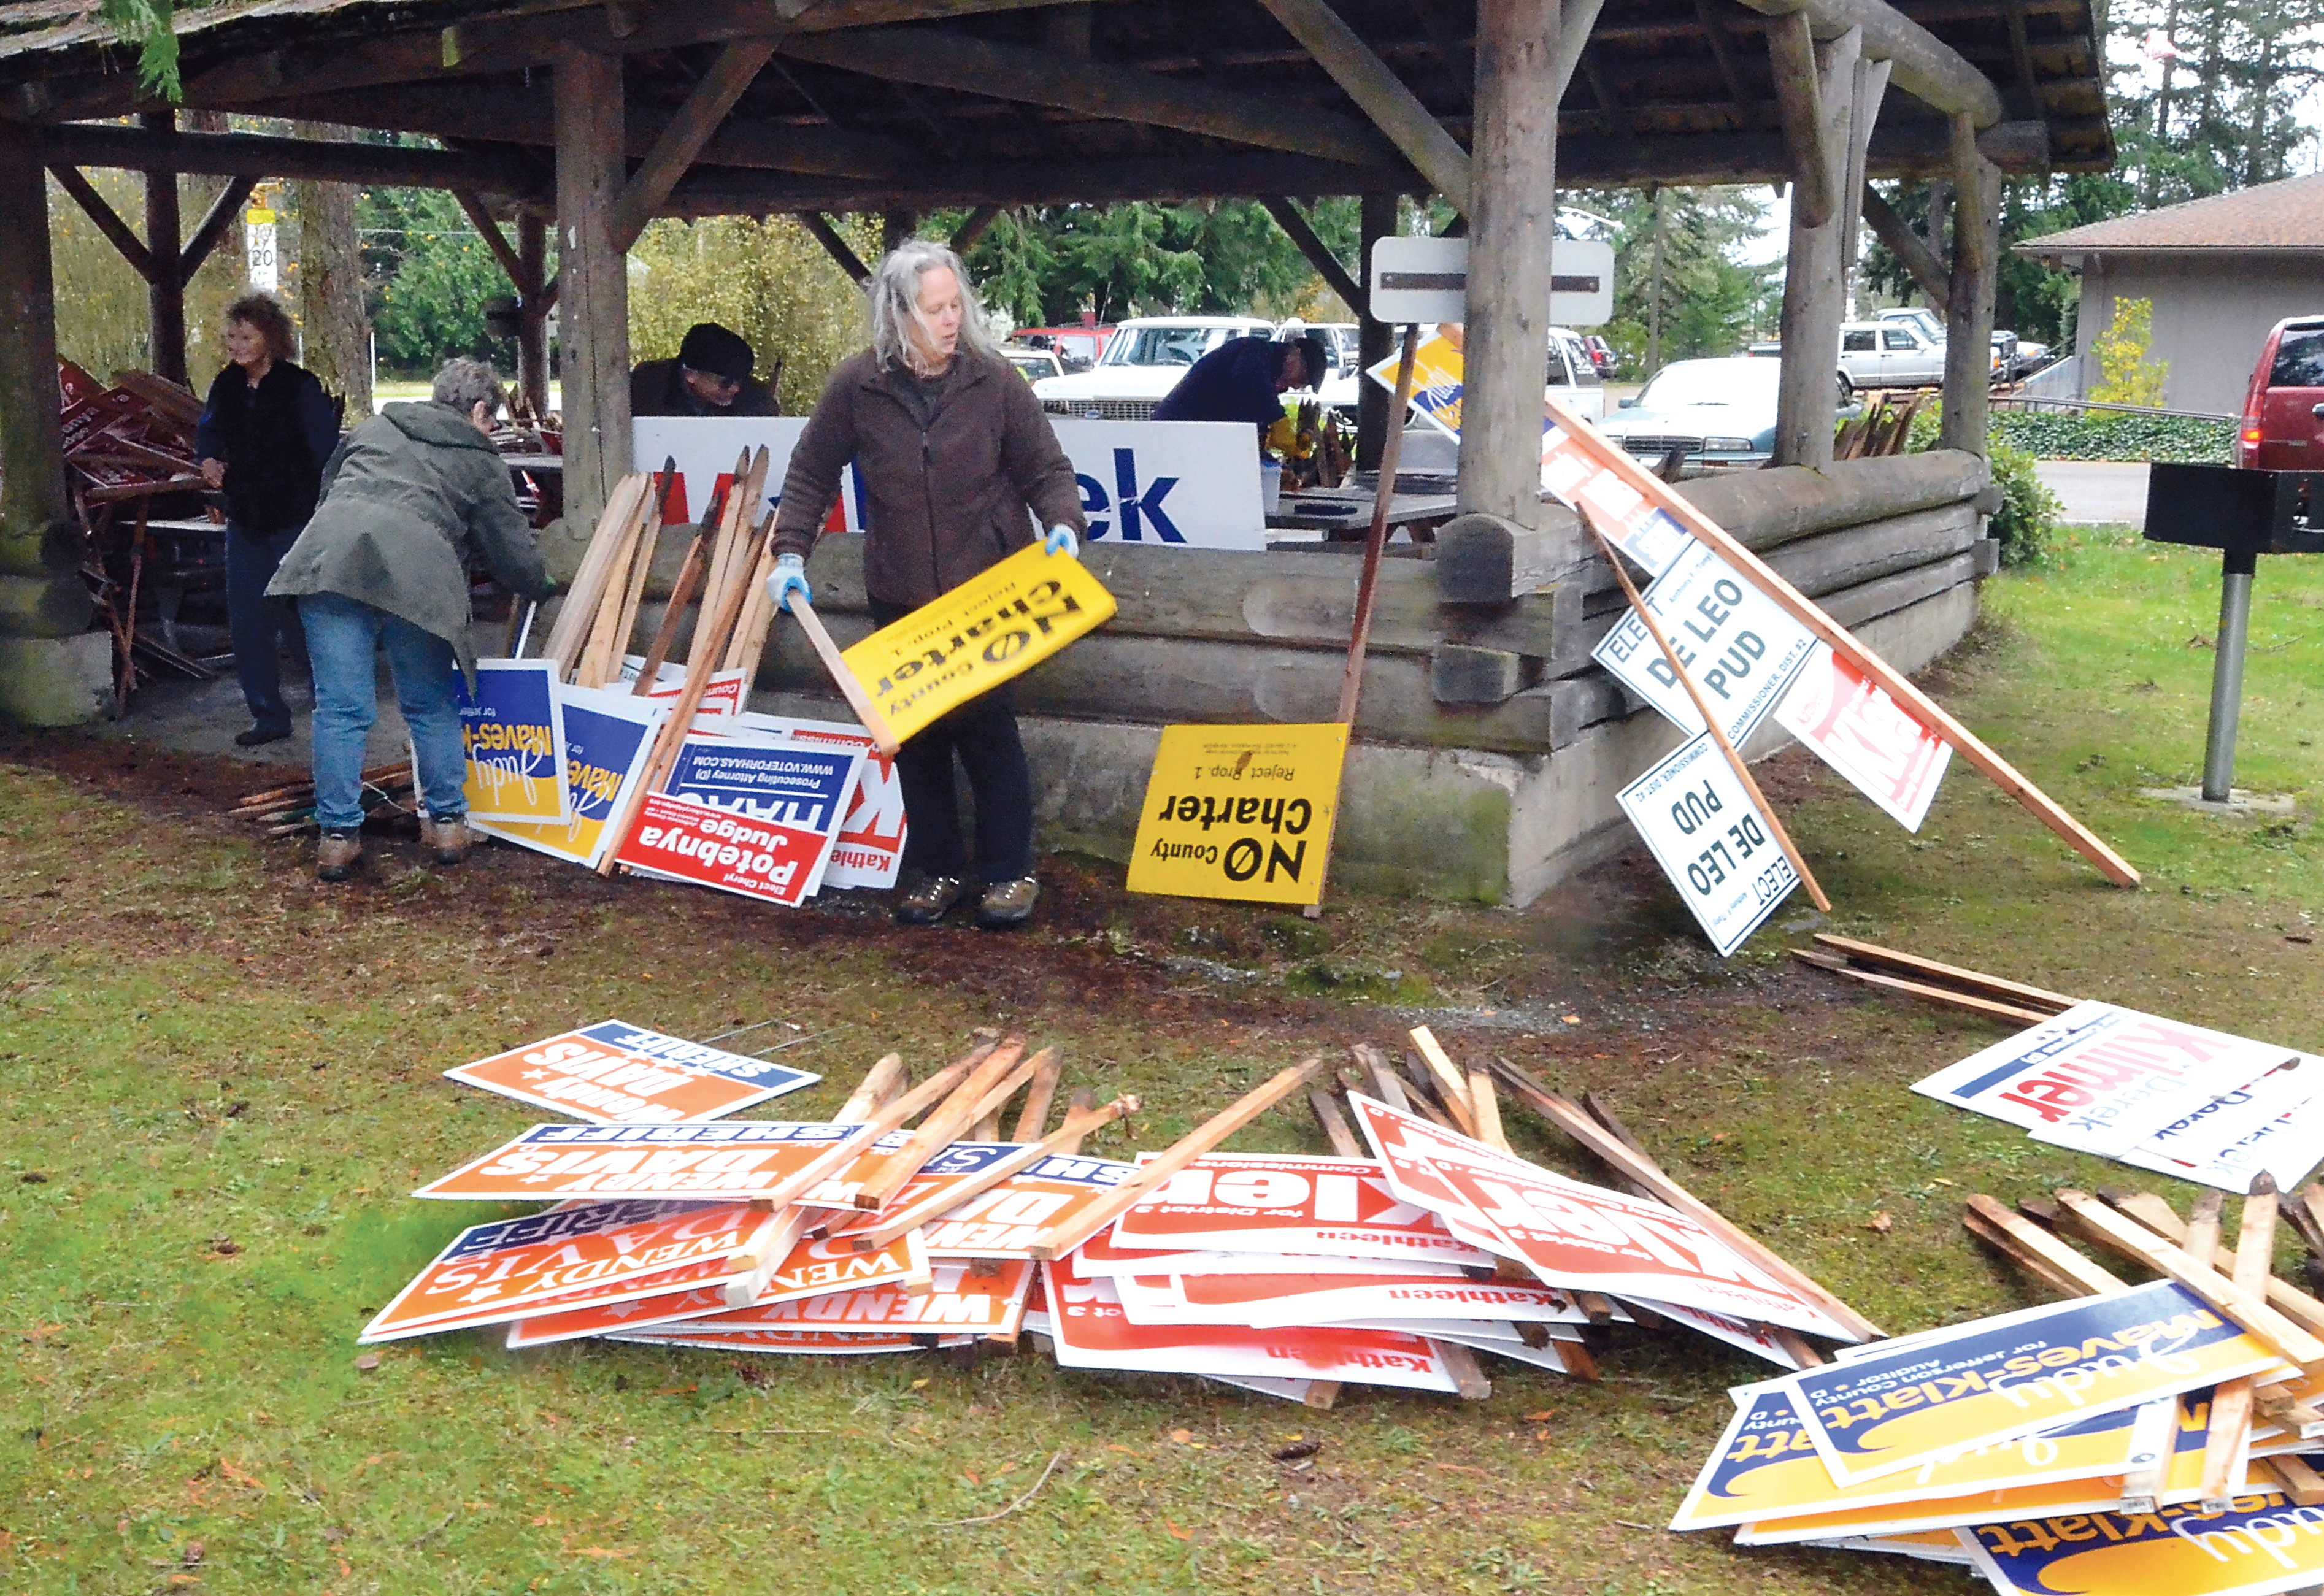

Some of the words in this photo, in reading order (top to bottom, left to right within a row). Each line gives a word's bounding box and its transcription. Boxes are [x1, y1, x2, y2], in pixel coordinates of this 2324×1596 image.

[253, 250, 272, 266] 20
[1683, 578, 1744, 643] LEO
[875, 580, 1062, 698] Charter
[982, 595, 1081, 664] NO
[1609, 596, 1666, 664] ELET
[1704, 629, 1766, 700] PUD
[889, 662, 973, 717] County
[472, 740, 543, 806] Judy
[693, 755, 834, 775] WWW.VOTEFORHAAS.COM
[696, 769, 712, 781] (D)
[712, 770, 755, 783] Attorney
[758, 773, 820, 789] Prosecuting
[1194, 767, 1202, 780] 1
[1208, 765, 1242, 781] Prop.
[1250, 764, 1295, 781] Reject
[1158, 796, 1312, 835] Charter
[1671, 778, 1723, 835] PUD
[700, 818, 788, 852] Judge
[1150, 838, 1218, 865] County
[1728, 813, 1766, 859] DE
[638, 826, 798, 886] Potebnya
[1223, 837, 1307, 884] NO
[1687, 839, 1737, 896] LEO
[723, 873, 758, 889] Cheryl
[758, 880, 787, 896] Elect
[1752, 856, 1793, 907] ELECT
[521, 1042, 694, 1098] DAVIS
[612, 1029, 771, 1078] SHERIFF
[1997, 1021, 2233, 1124] Kilmer
[529, 1076, 686, 1121] Wendy
[2066, 1075, 2186, 1132] Derek
[536, 1124, 852, 1144] SHERIFF
[479, 1148, 780, 1176] DAVIS
[553, 1170, 778, 1192] WENDY
[1152, 1205, 1258, 1216] District
[1263, 1208, 1303, 1218] for
[425, 1208, 748, 1295] DAVIS
[1316, 1231, 1479, 1254] Kathleen
[520, 1230, 738, 1294] WENDY
[761, 1293, 990, 1322] WENDY
[1389, 1286, 1554, 1307] Kathleen
[1988, 1322, 2200, 1408] Judy
[2009, 1340, 2048, 1355] for
[1819, 1308, 2223, 1429] Maves-Klatt
[1857, 1359, 1941, 1387] Auditor
[1901, 1350, 2006, 1385] Jefferson
